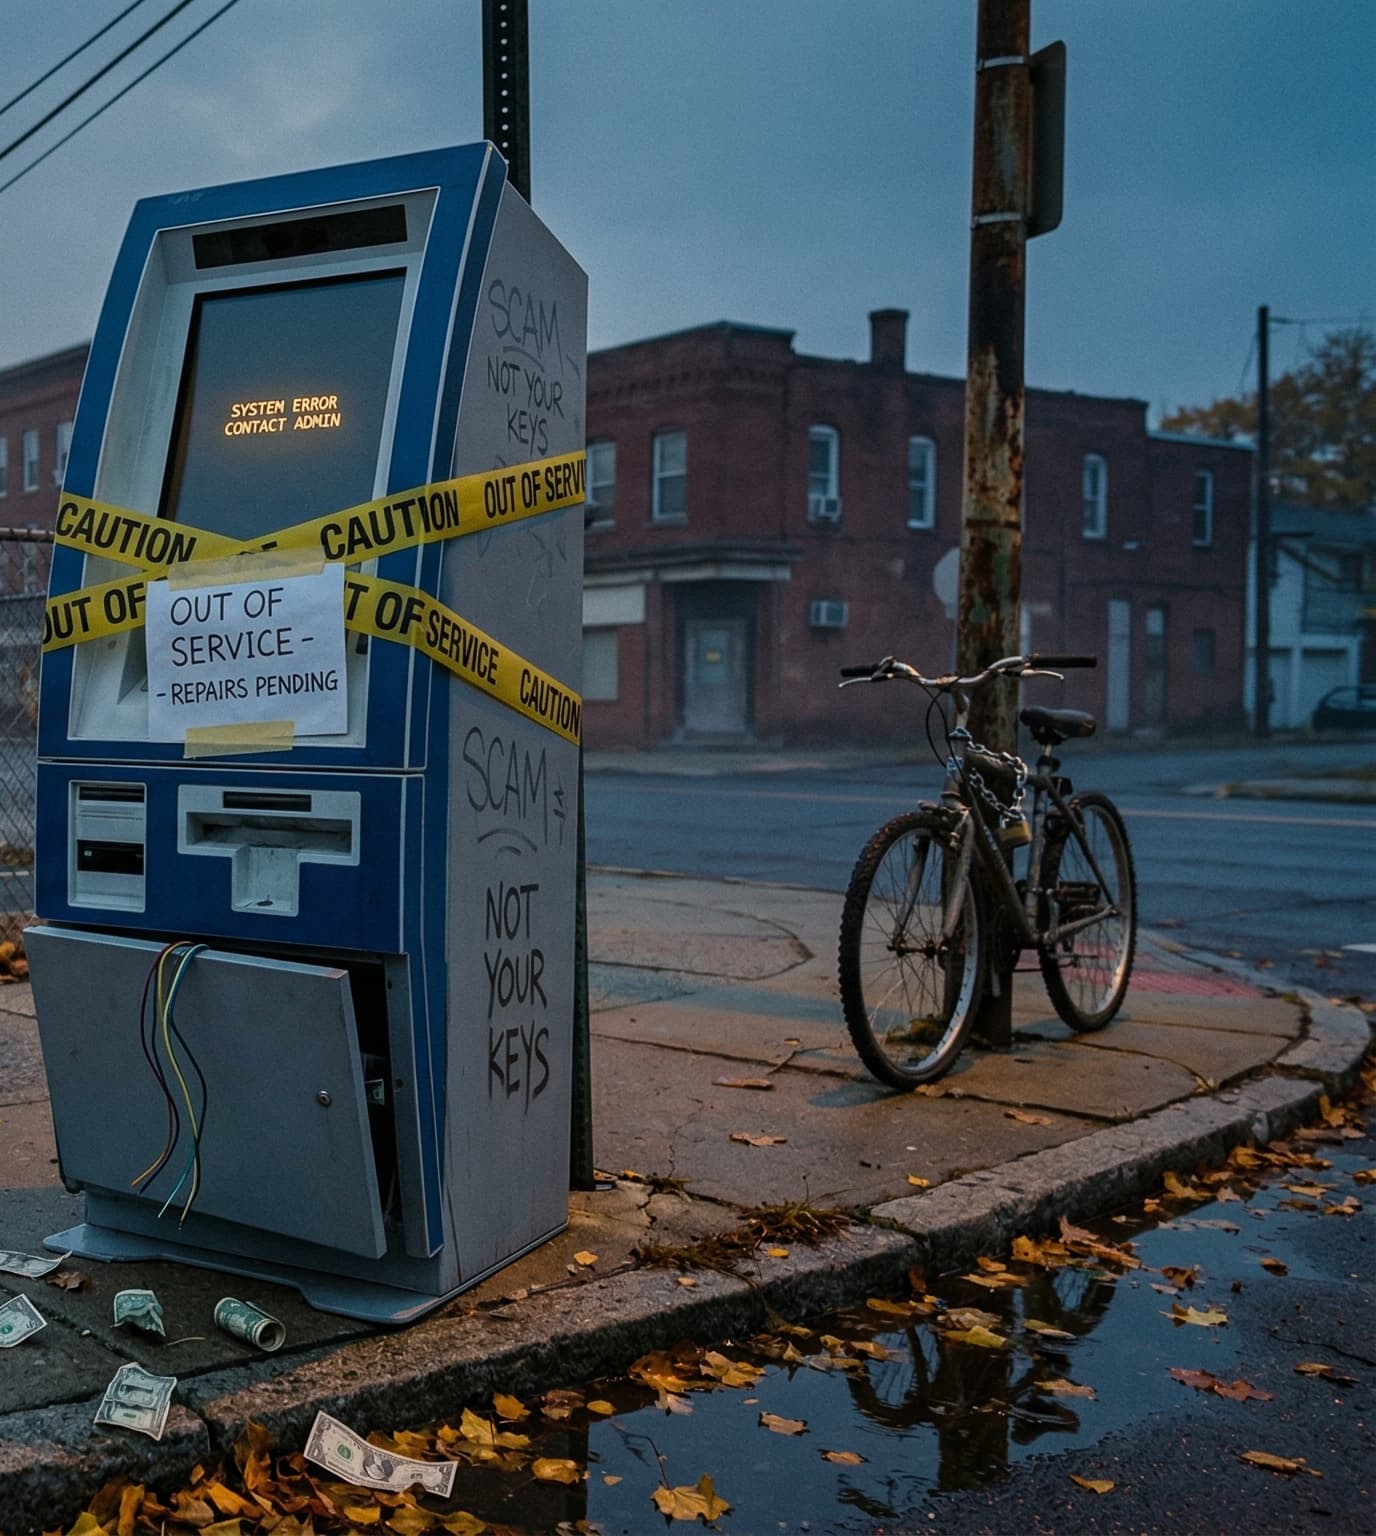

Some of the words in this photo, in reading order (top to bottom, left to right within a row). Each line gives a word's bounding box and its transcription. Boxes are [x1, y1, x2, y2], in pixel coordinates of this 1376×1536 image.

[488, 279, 564, 376] SCAM
[231, 400, 284, 418] SYSTEM
[292, 395, 338, 412] ERROR
[487, 355, 521, 396] NOT
[524, 368, 564, 419] YOUR
[224, 418, 287, 436] CONTACT
[293, 413, 341, 430] ADMIN
[506, 403, 550, 456] KEYS
[56, 502, 197, 566] CAUTION
[320, 489, 460, 560] CAUTION
[484, 475, 516, 519] OUT
[520, 469, 541, 508] OF
[545, 459, 586, 502] SERVI
[104, 582, 146, 625] OF
[171, 592, 233, 625] OUT
[244, 587, 284, 618] OF
[256, 670, 338, 697] PENDING
[375, 591, 426, 635] OF
[426, 609, 499, 686] SERVICE
[520, 669, 581, 737] CAUTION
[463, 727, 548, 845] SCAM
[485, 881, 539, 941] NOT
[484, 948, 547, 1020] YOUR
[488, 1020, 550, 1115] KEYS
